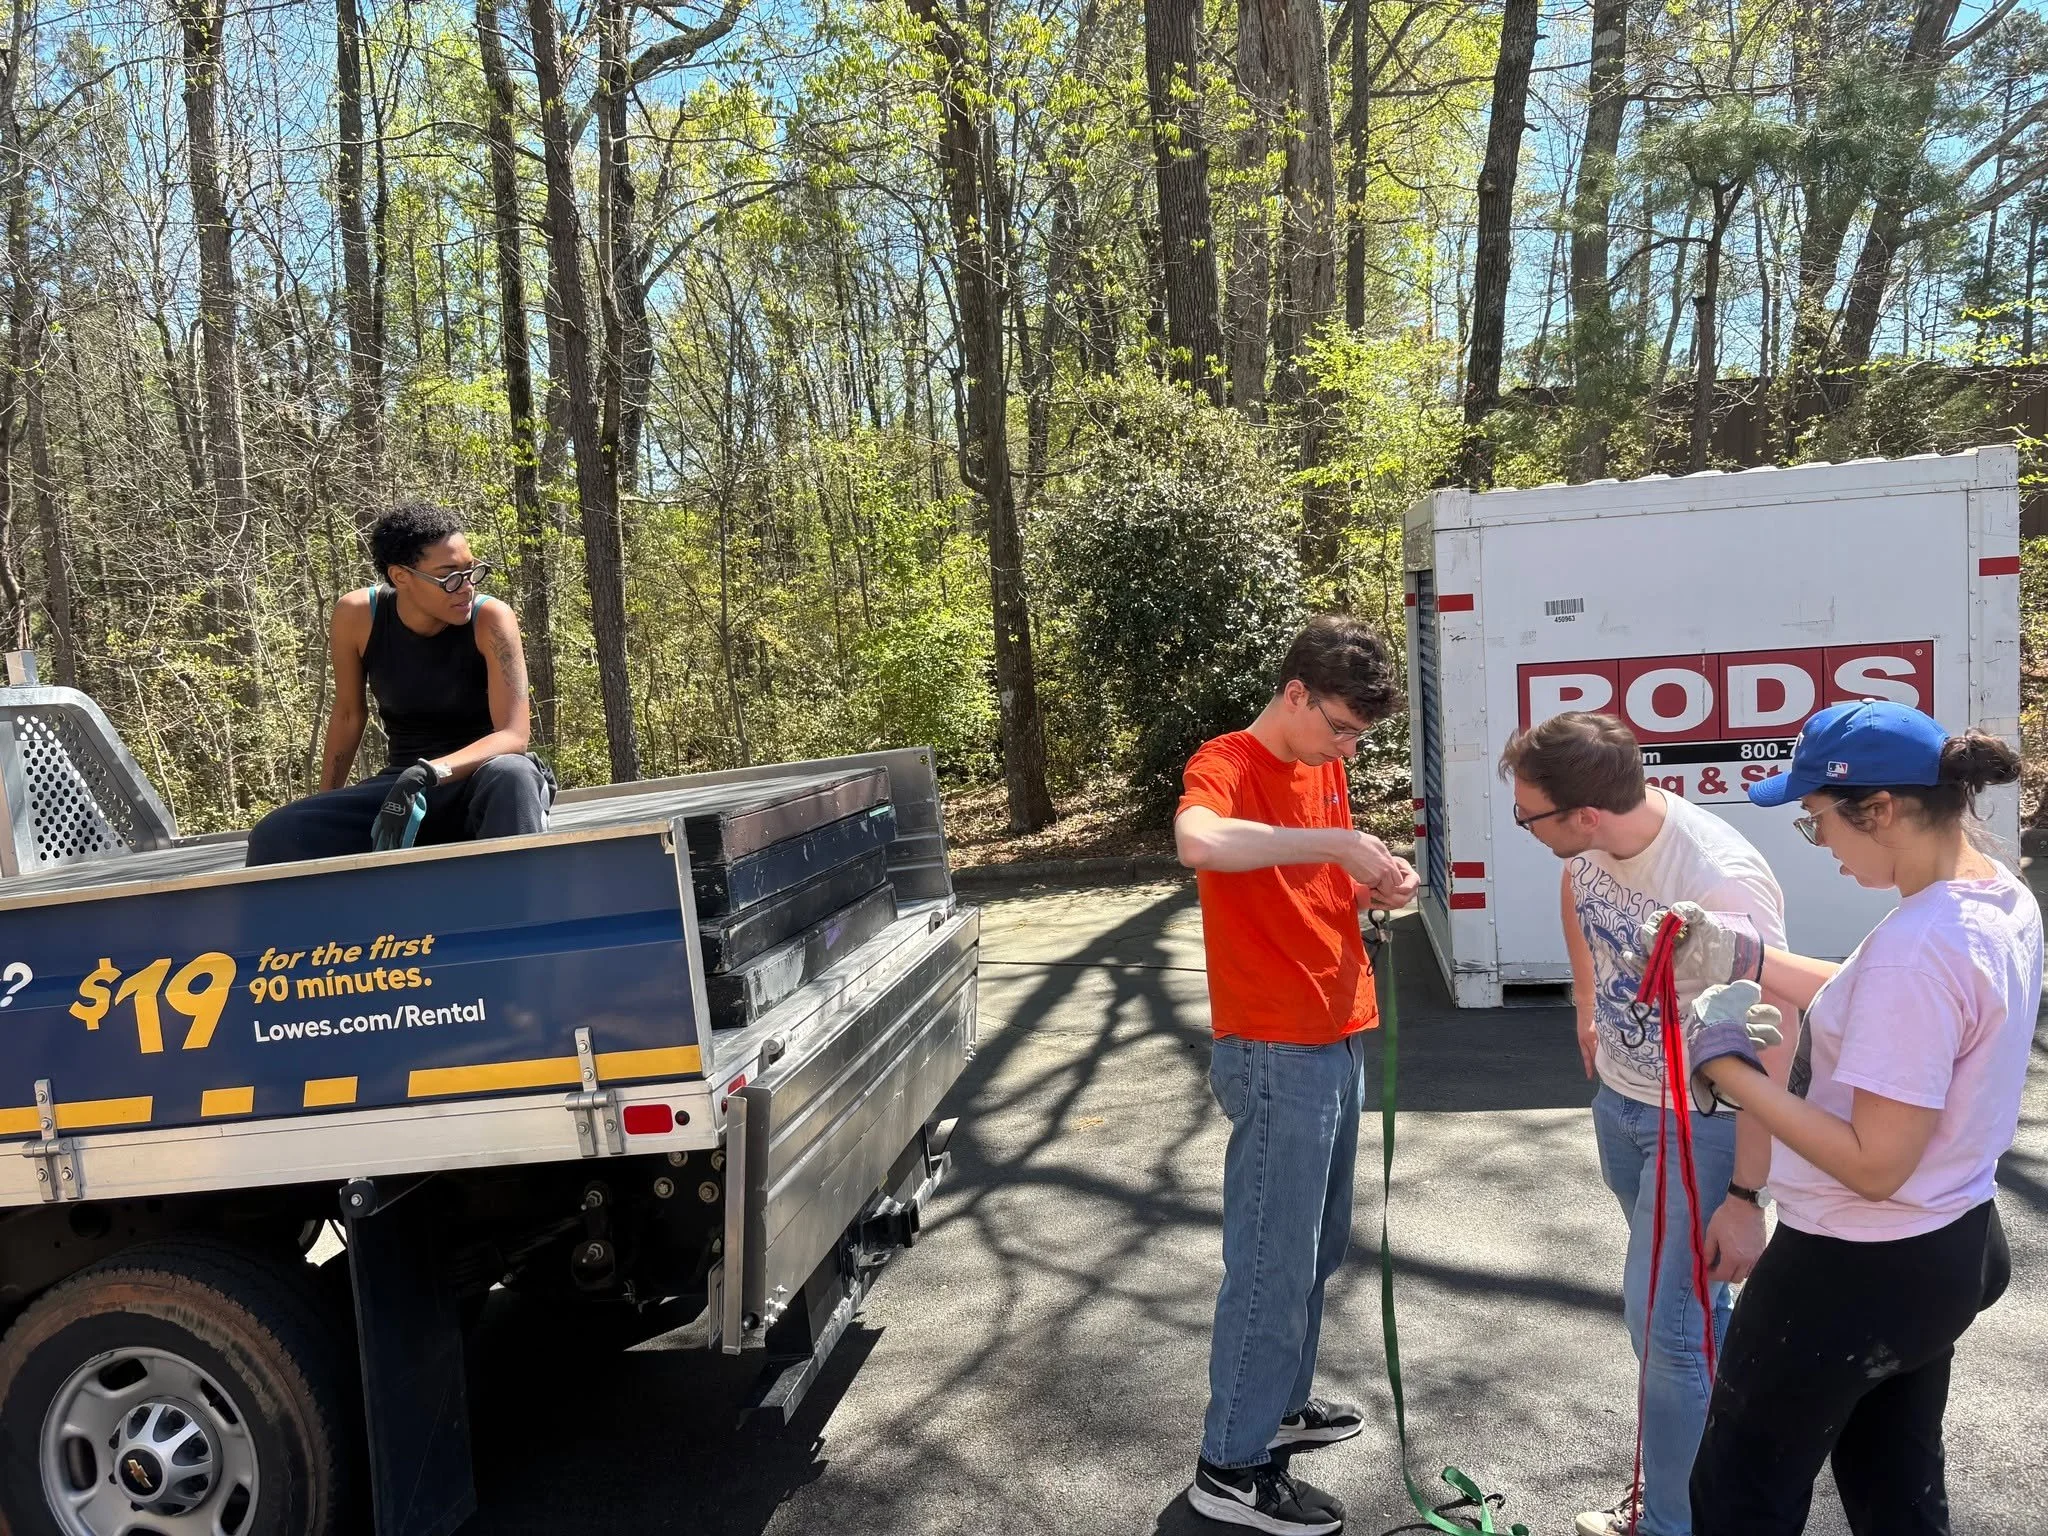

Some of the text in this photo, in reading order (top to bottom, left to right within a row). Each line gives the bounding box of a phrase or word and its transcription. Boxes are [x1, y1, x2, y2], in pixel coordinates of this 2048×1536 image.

[1554, 615, 1576, 623] 450963
[1529, 656, 1920, 732] PODS
[1697, 766, 1729, 795] &
[257, 934, 435, 972] for the first
[69, 952, 237, 1053] $19
[249, 967, 433, 1004] 90 minutes.
[254, 998, 486, 1042] Lowes.com/Rental
